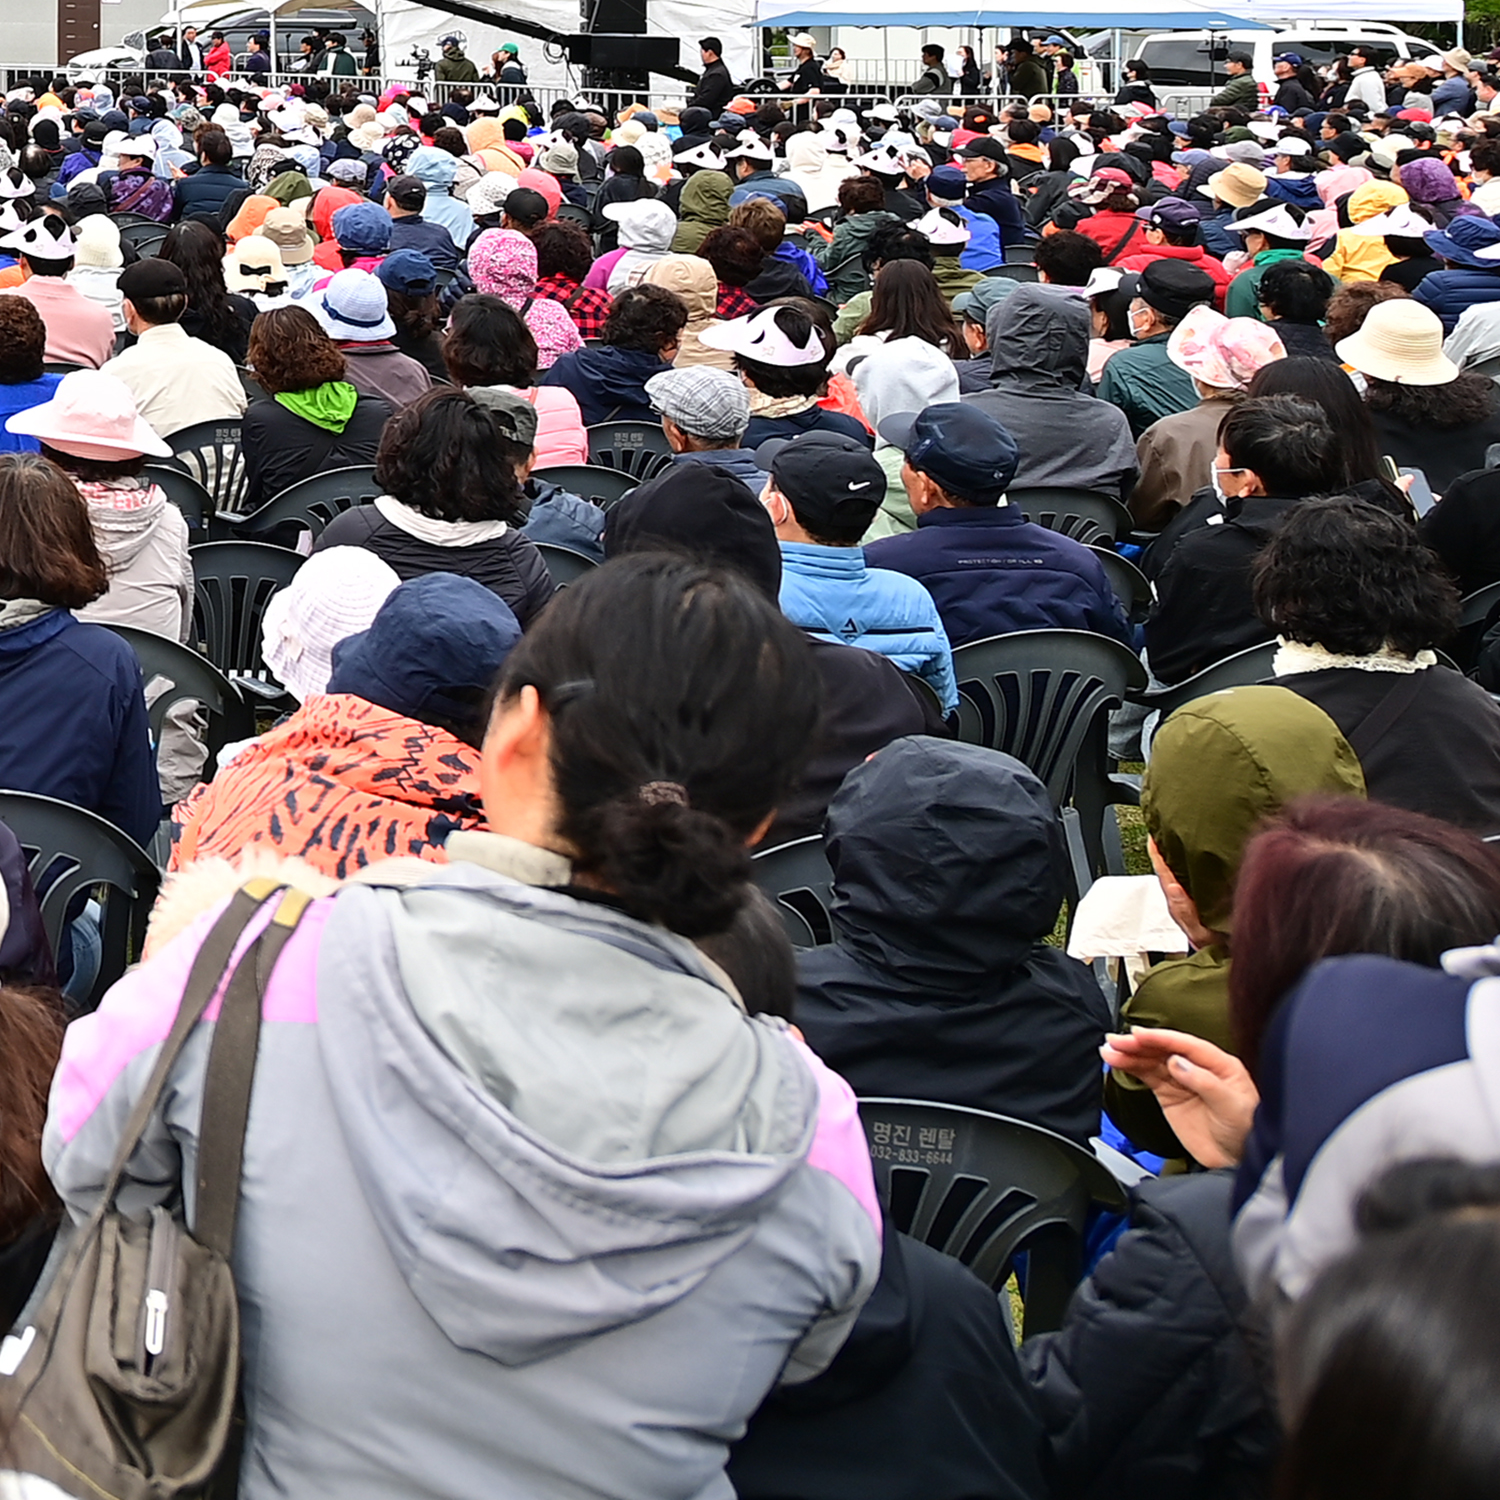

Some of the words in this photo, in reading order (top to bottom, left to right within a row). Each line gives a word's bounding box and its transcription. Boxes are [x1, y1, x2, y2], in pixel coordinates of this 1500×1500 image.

[873, 1121, 912, 1147] 명진
[918, 1127, 957, 1150] 렌탈
[870, 1145, 953, 1165] 032-833-6644
